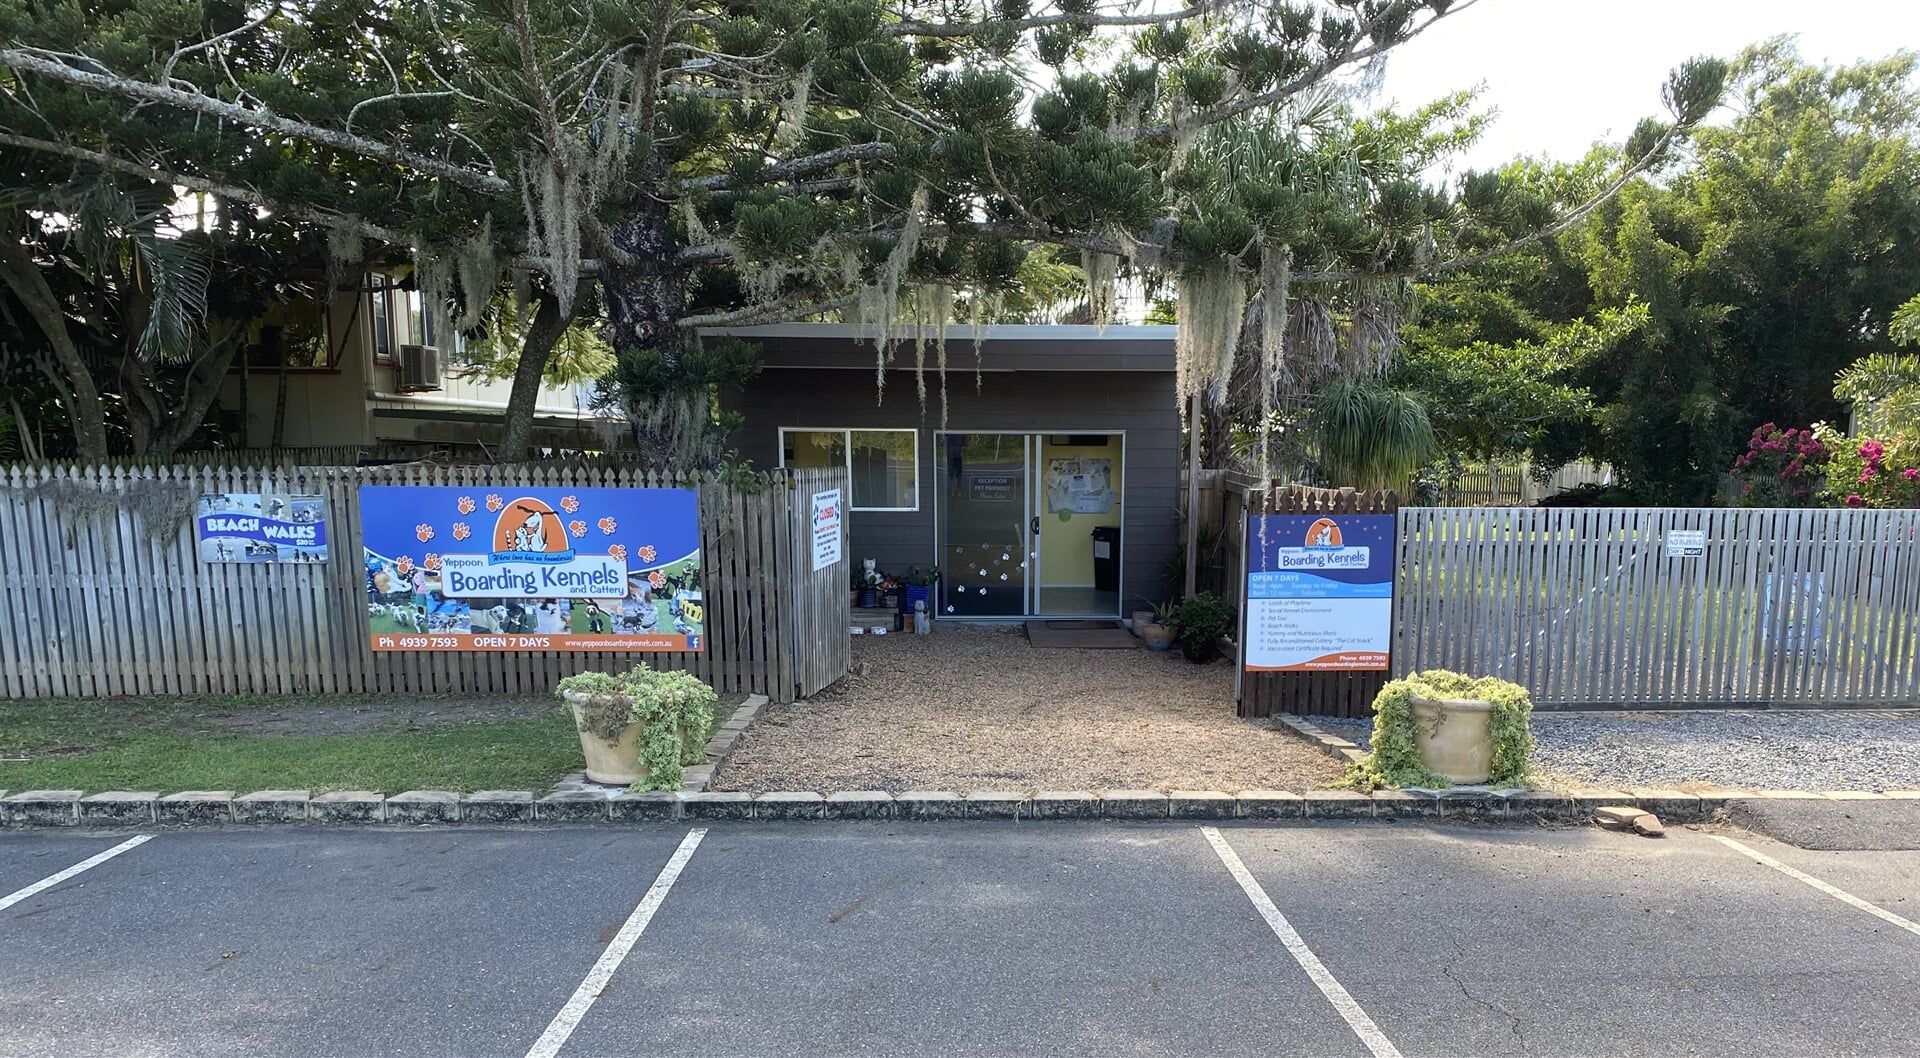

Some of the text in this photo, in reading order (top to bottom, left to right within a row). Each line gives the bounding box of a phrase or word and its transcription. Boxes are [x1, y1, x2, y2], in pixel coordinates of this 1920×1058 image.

[207, 518, 316, 539] BEACH WALKS
[443, 557, 483, 569] Yeppoon
[492, 553, 511, 562] Where
[512, 553, 524, 562] love
[1282, 550, 1365, 567] Boarding Kennels
[450, 562, 620, 595] Boarding Kennels
[570, 584, 625, 596] and Cattery
[379, 637, 550, 648] Ph 4939 7593 OPEN 7 DAYS
[564, 638, 673, 649] www.yeppoonboardingkennels.com.au
